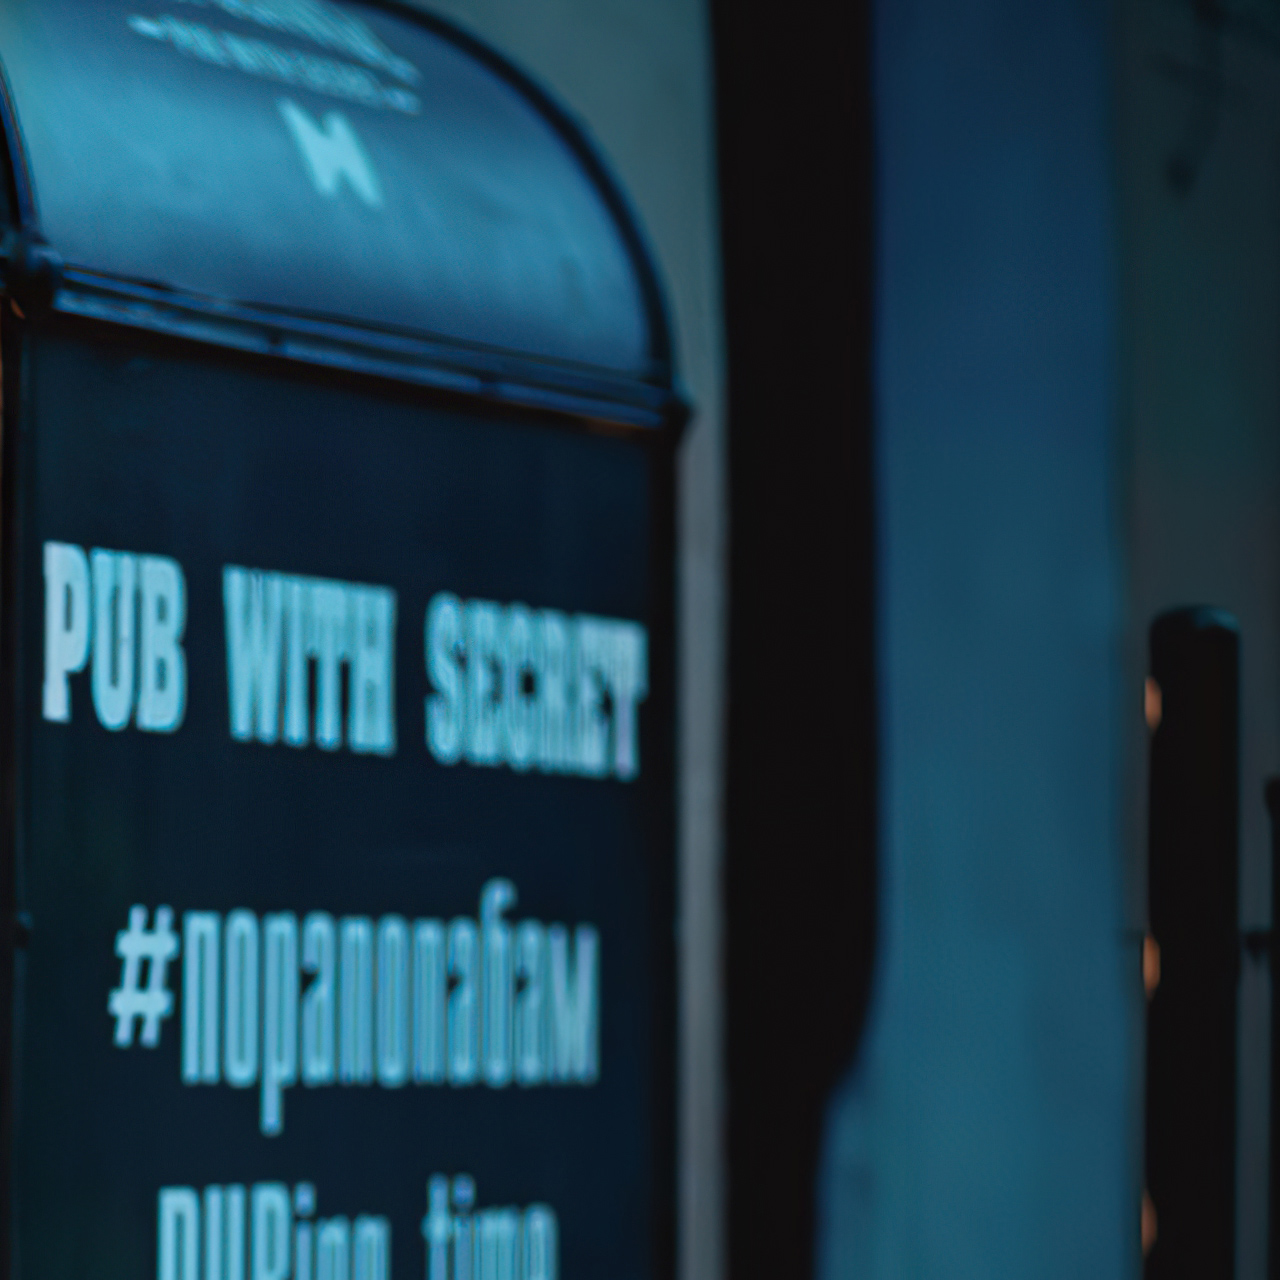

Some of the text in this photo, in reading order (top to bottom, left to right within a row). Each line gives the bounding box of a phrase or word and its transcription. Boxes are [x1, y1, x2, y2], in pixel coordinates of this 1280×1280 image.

[42, 540, 647, 780] PUB WITH SECRET
